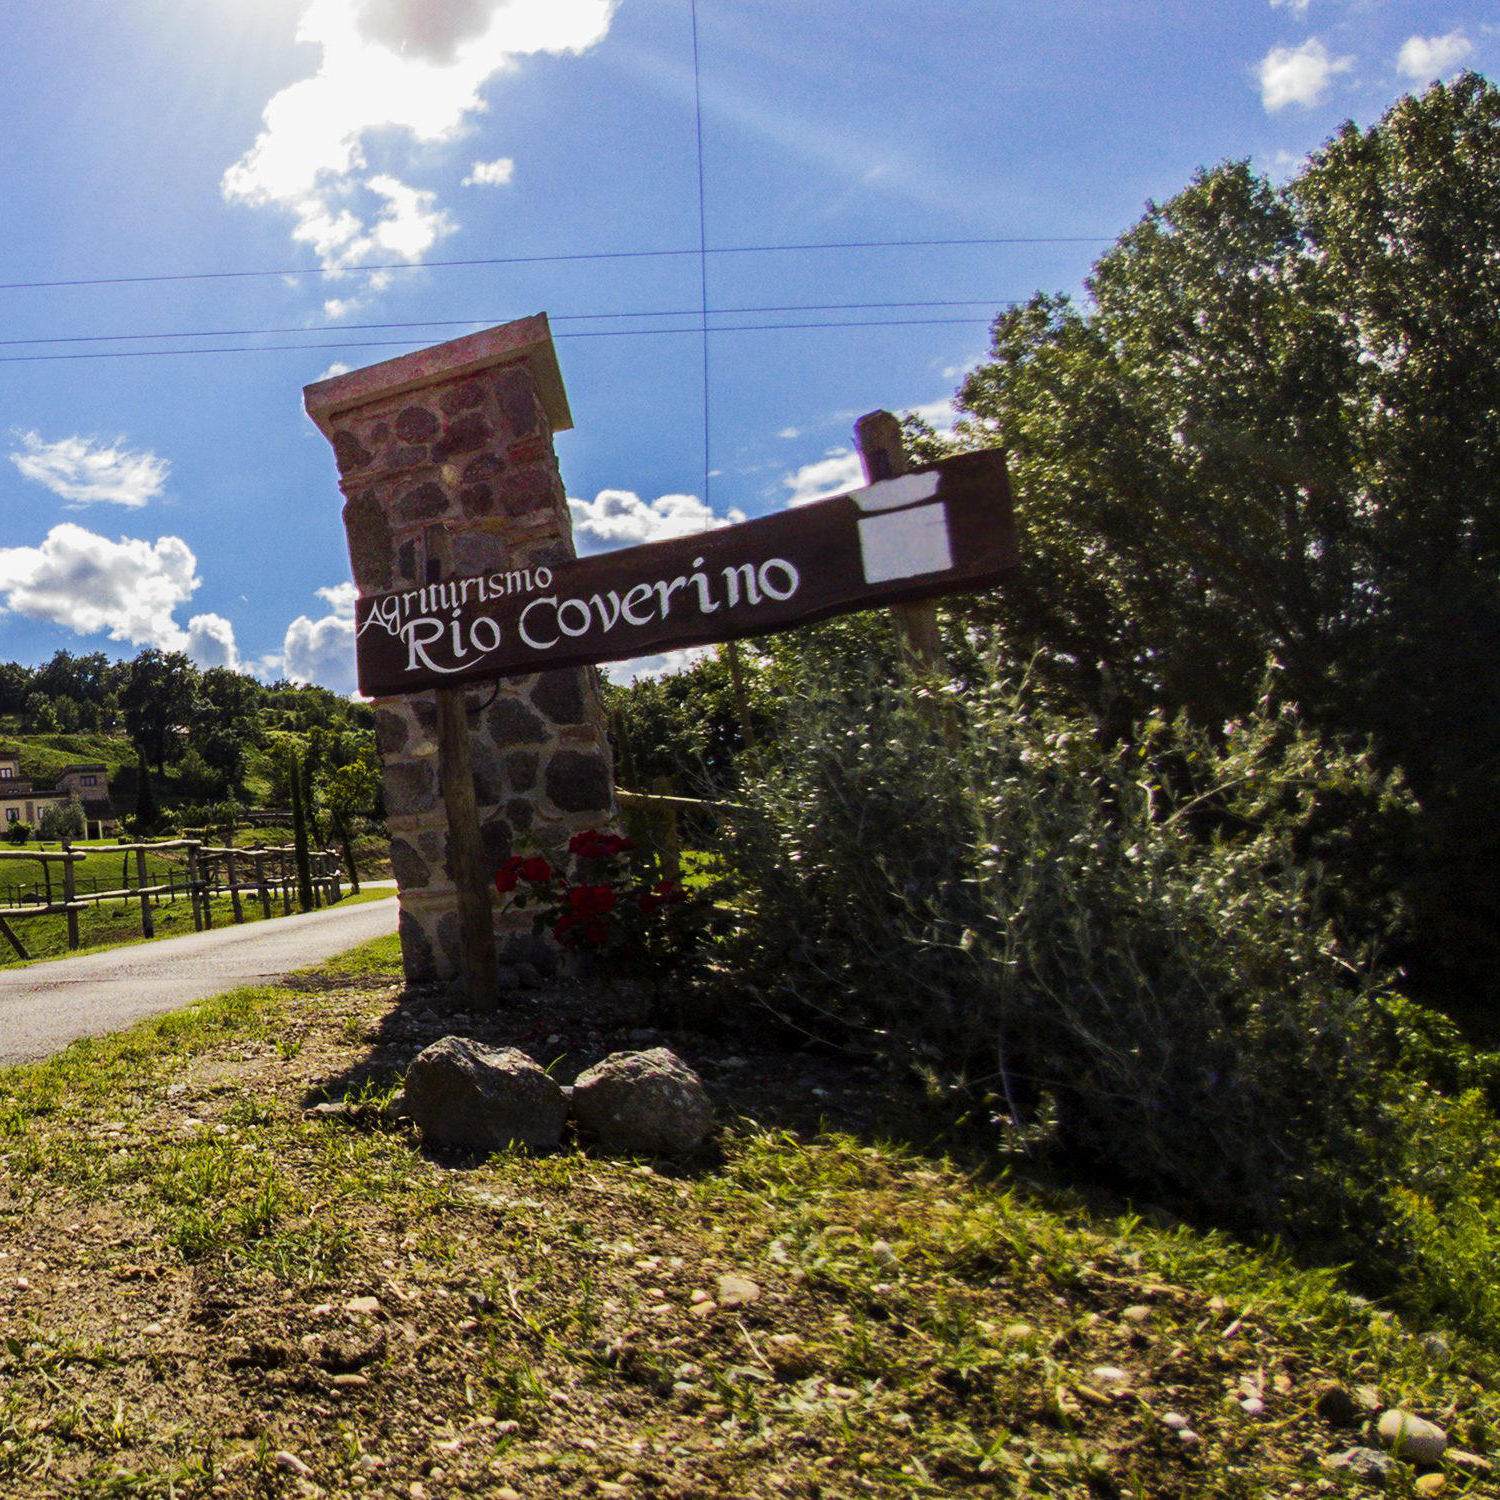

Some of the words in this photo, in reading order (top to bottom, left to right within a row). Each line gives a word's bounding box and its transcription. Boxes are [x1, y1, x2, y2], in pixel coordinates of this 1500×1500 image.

[357, 566, 552, 636] Agriturismo
[400, 608, 500, 674] Rio
[518, 556, 799, 650] Coverino
